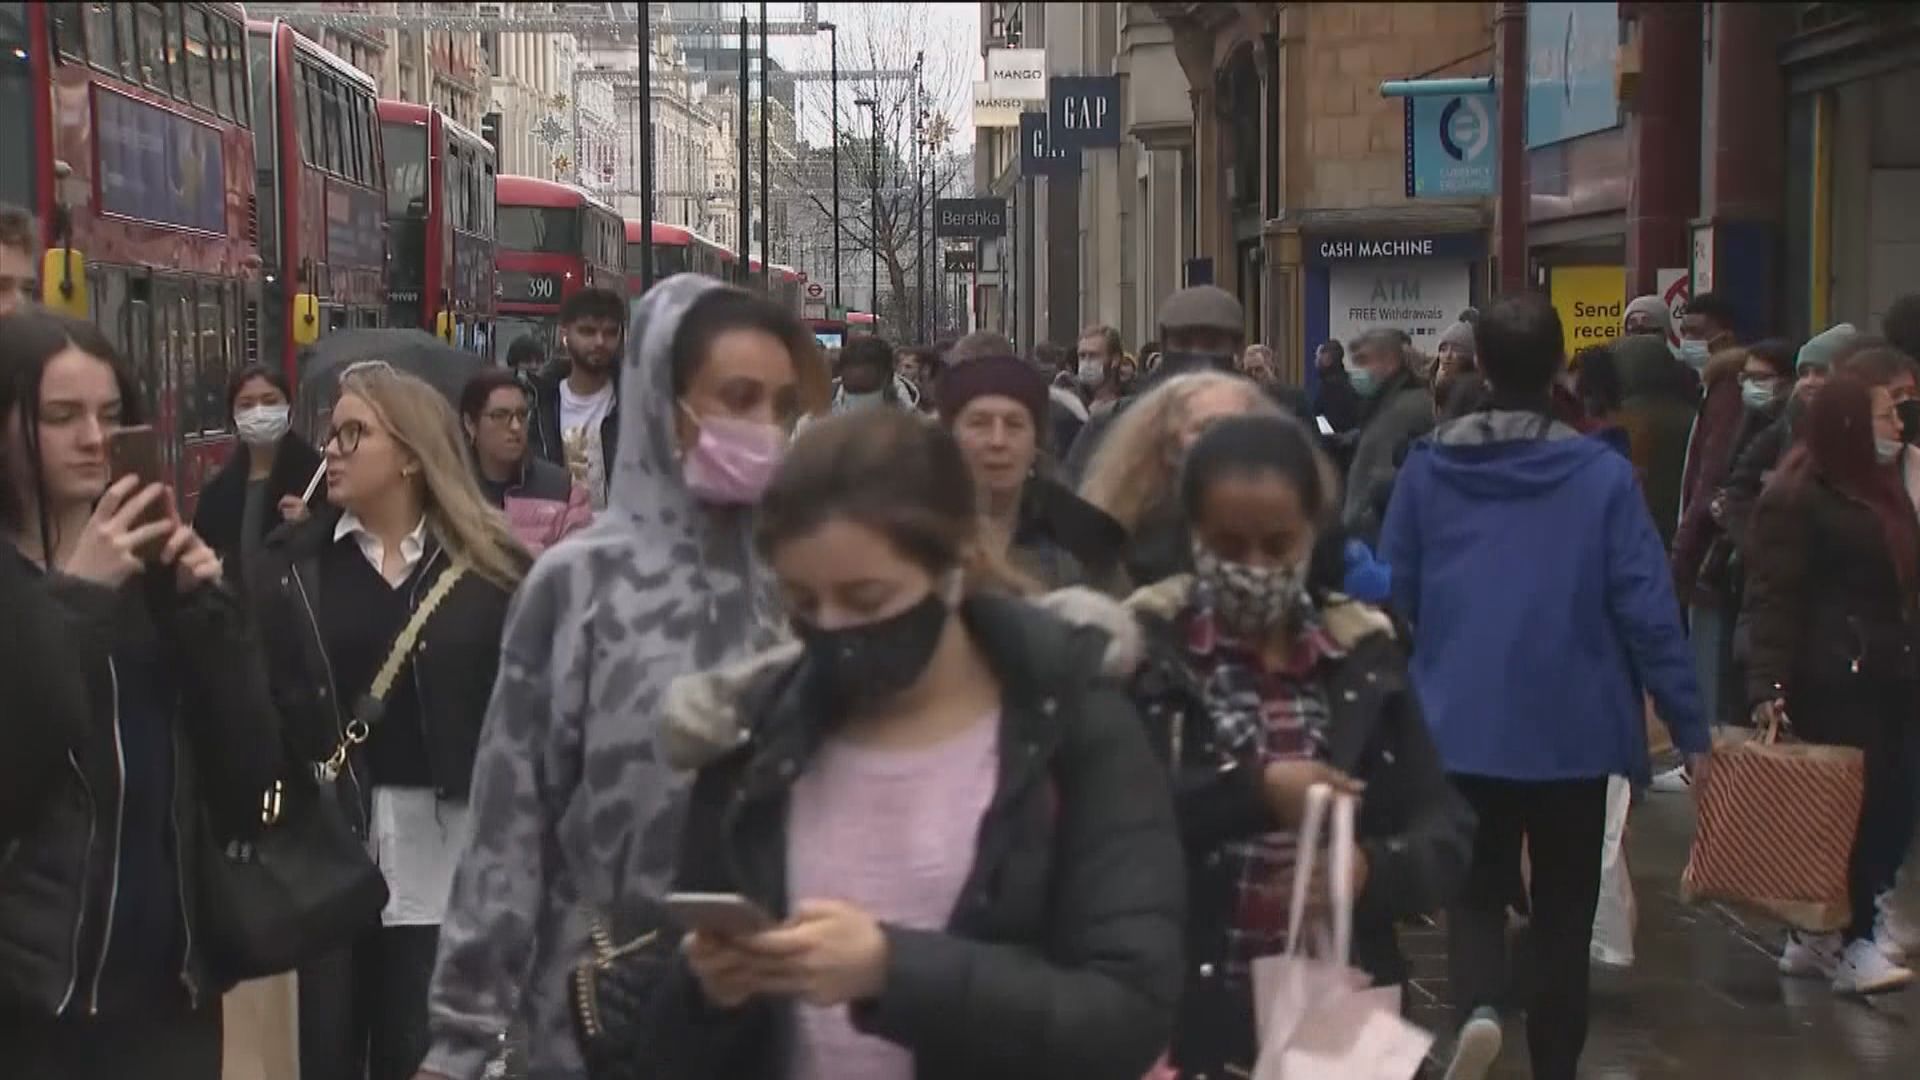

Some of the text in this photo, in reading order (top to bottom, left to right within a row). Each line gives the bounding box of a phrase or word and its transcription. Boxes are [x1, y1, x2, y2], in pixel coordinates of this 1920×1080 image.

[993, 69, 1042, 80] MANGO
[975, 99, 1021, 108] MANGO
[1064, 96, 1107, 129] GAP
[942, 210, 1000, 225] Bershka
[1320, 240, 1433, 257] CASH MACHINE
[528, 278, 553, 297] 390
[1371, 279, 1421, 302] ATM
[1350, 308, 1443, 320] FREE Withdrawals
[1574, 301, 1621, 317] Send
[1574, 322, 1624, 338] recei
